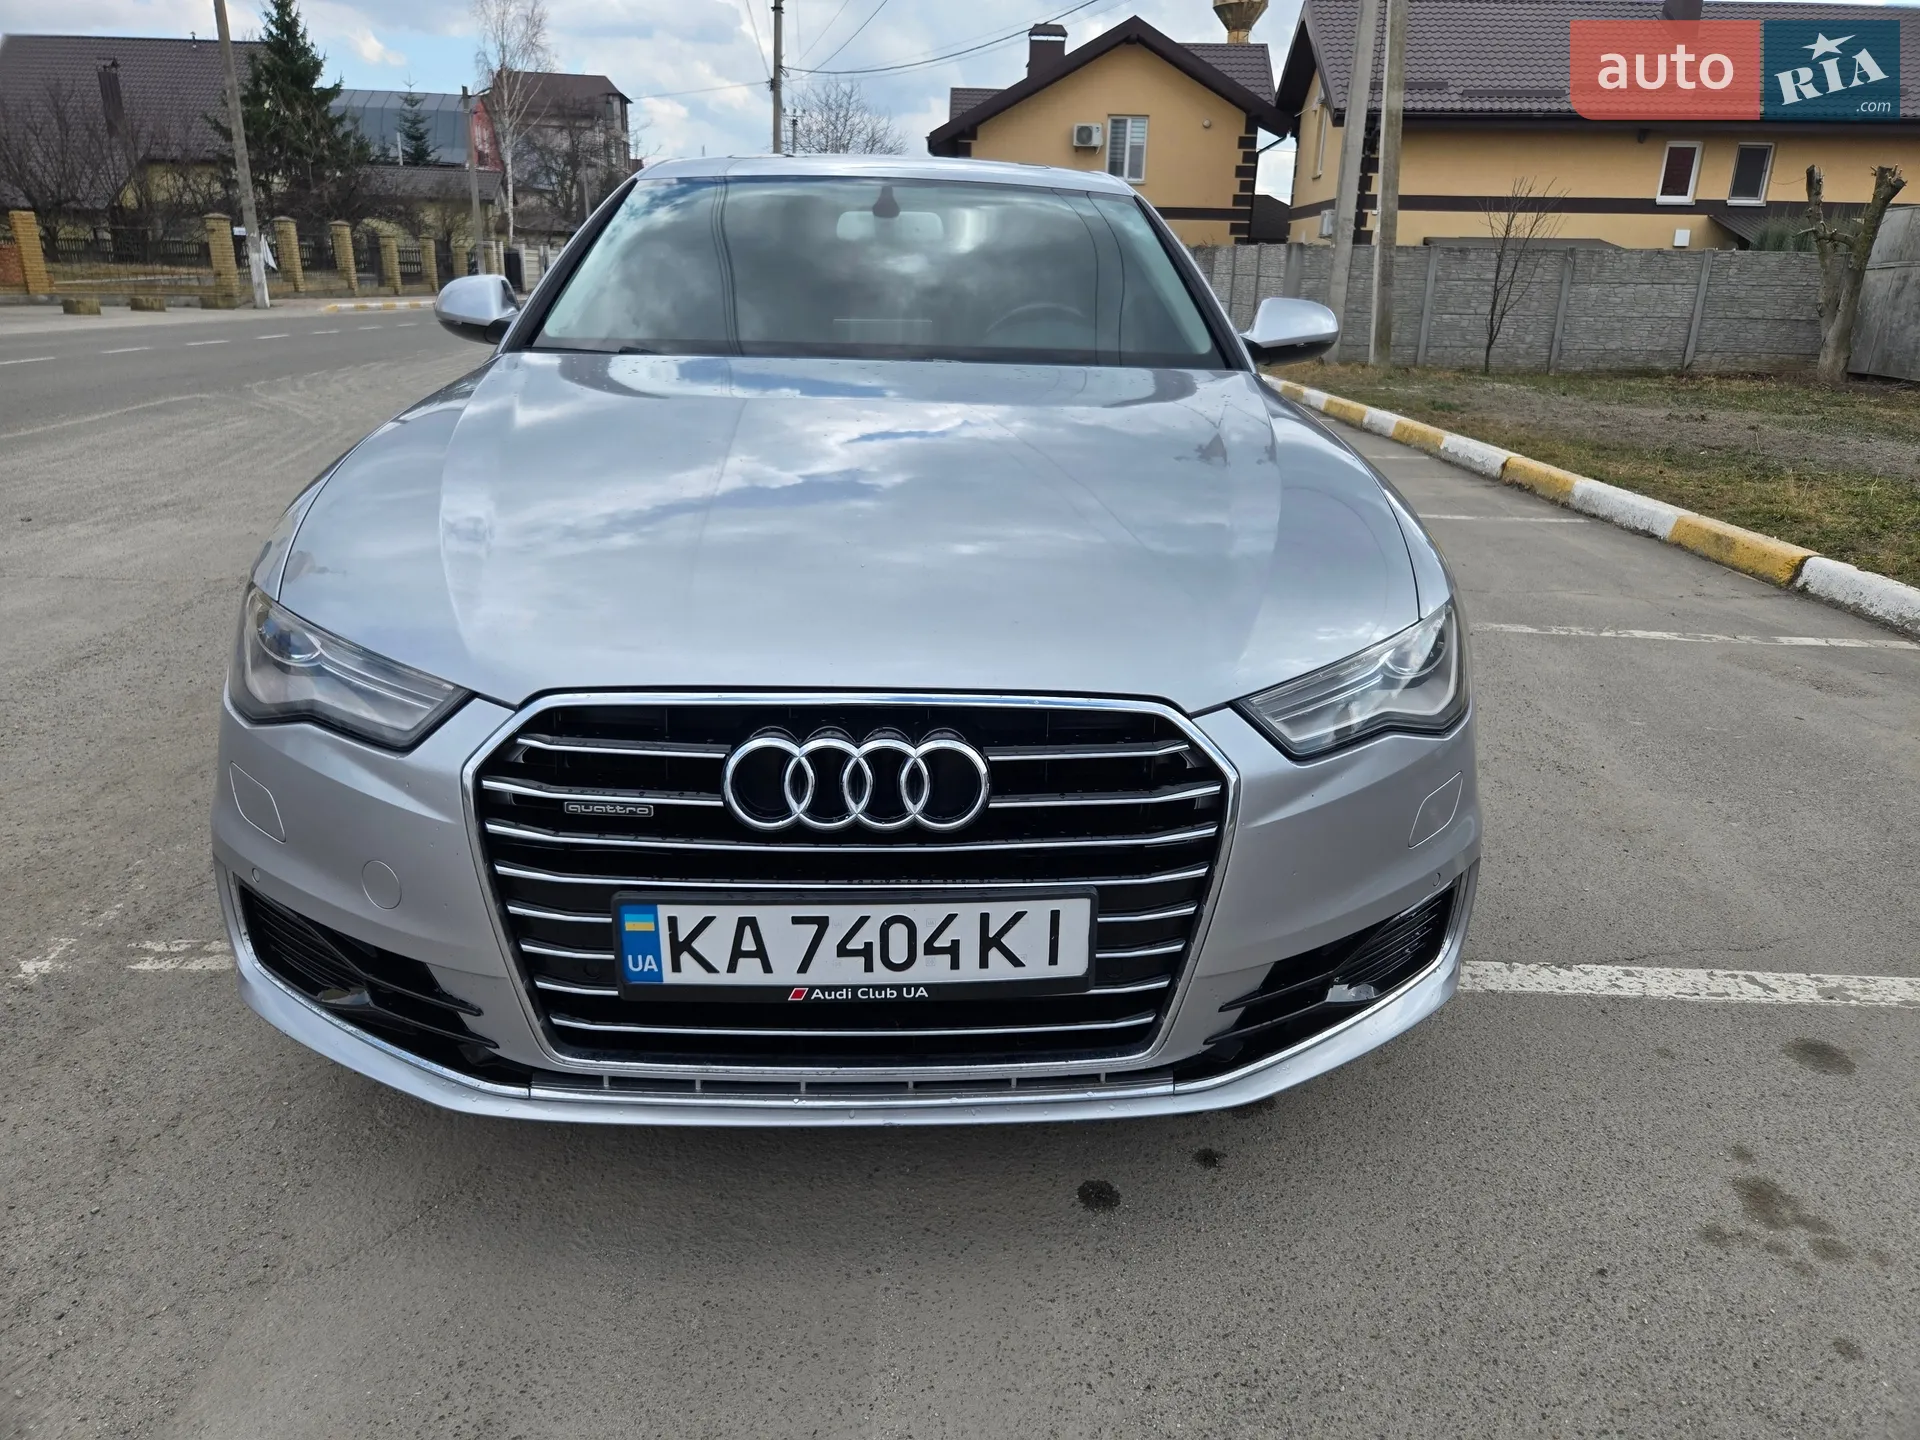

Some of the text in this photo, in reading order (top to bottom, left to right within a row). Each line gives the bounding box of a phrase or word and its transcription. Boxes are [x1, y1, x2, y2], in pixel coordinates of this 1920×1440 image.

[568, 804, 650, 815] quattro
[667, 909, 1061, 974] KA 7404 KI
[627, 954, 659, 972] UA
[811, 986, 929, 999] Audi Club UA
